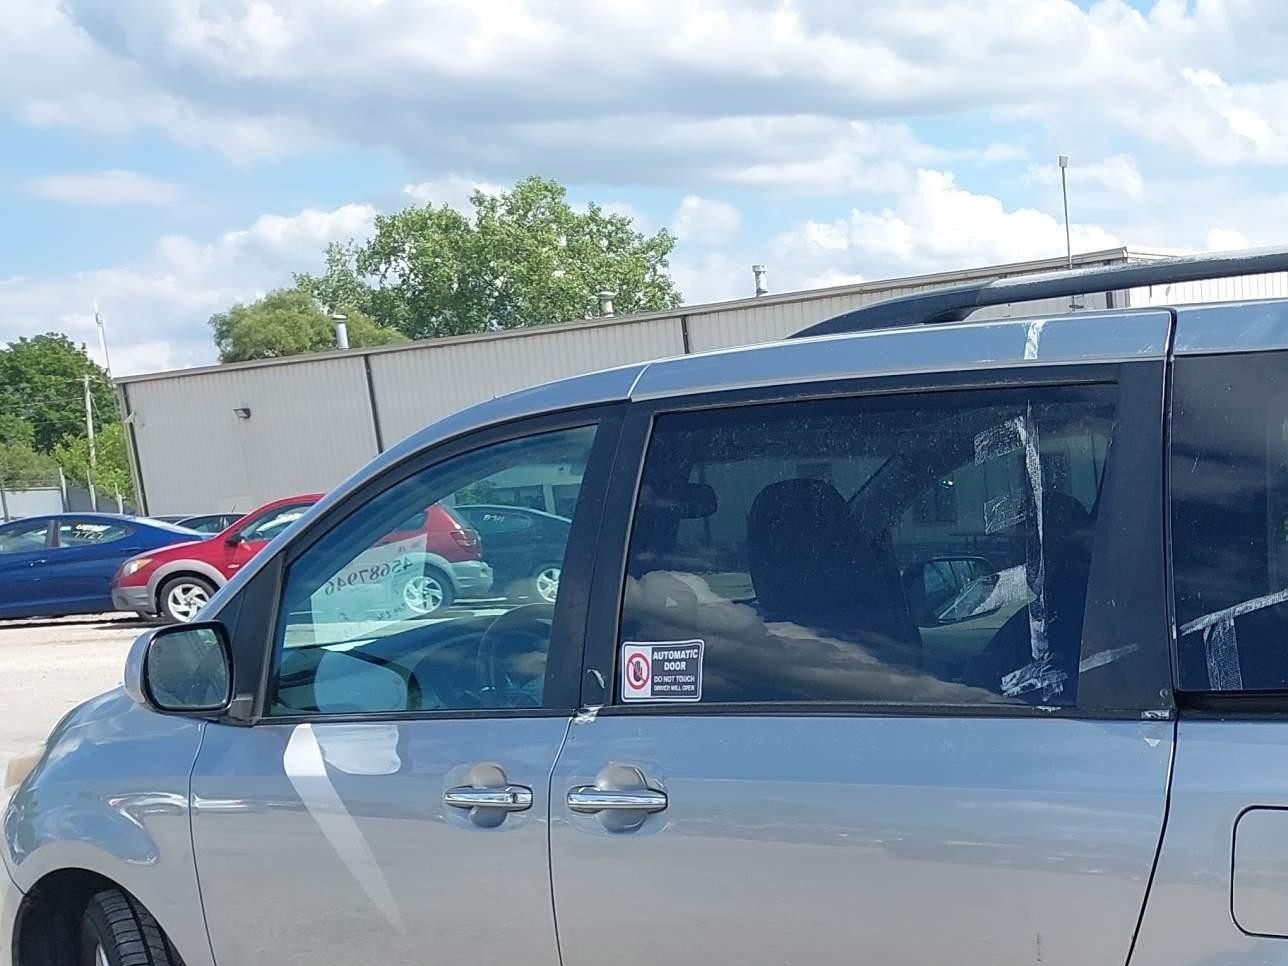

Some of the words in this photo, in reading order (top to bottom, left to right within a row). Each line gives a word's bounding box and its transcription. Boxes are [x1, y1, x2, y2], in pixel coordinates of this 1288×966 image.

[653, 649, 699, 660] AUTOMATIC
[664, 661, 687, 670] DOOR
[676, 675, 695, 683] TOUCH
